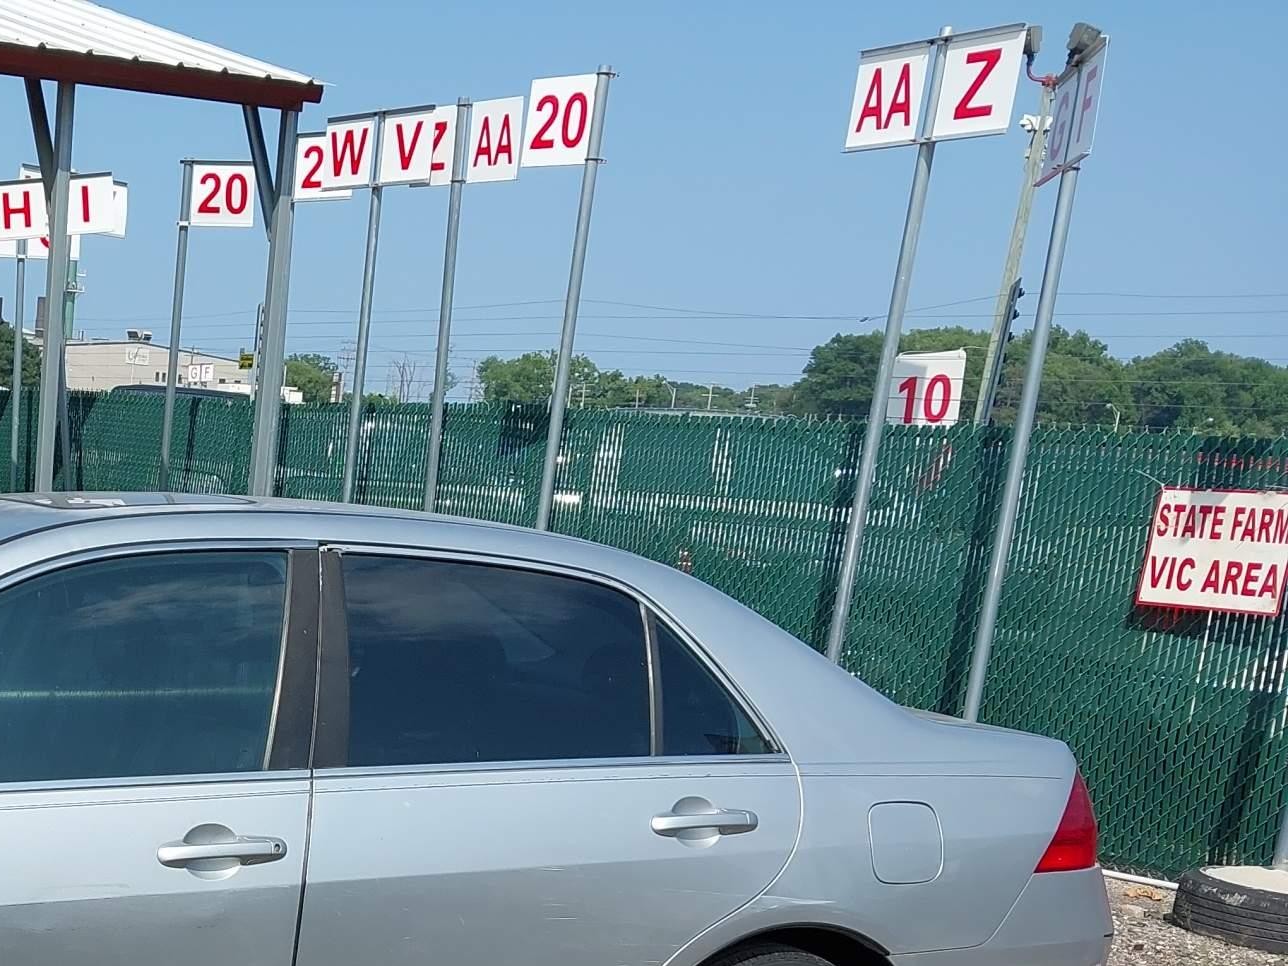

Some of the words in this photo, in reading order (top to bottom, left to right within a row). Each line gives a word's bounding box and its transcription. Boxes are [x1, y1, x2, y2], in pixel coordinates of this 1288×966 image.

[856, 62, 911, 133] AA
[953, 48, 1002, 121] Z
[1050, 91, 1069, 161] G
[1076, 65, 1098, 143] F
[473, 113, 513, 167] AA
[530, 91, 589, 151] 20
[331, 127, 369, 177] W
[395, 121, 423, 170] V
[2, 190, 31, 231] H
[80, 185, 90, 223] I
[197, 172, 249, 216] 20
[898, 374, 952, 424] 10
[1156, 503, 1227, 540] STATE
[1149, 556, 1196, 592] VIC
[1200, 559, 1279, 599] AREA
